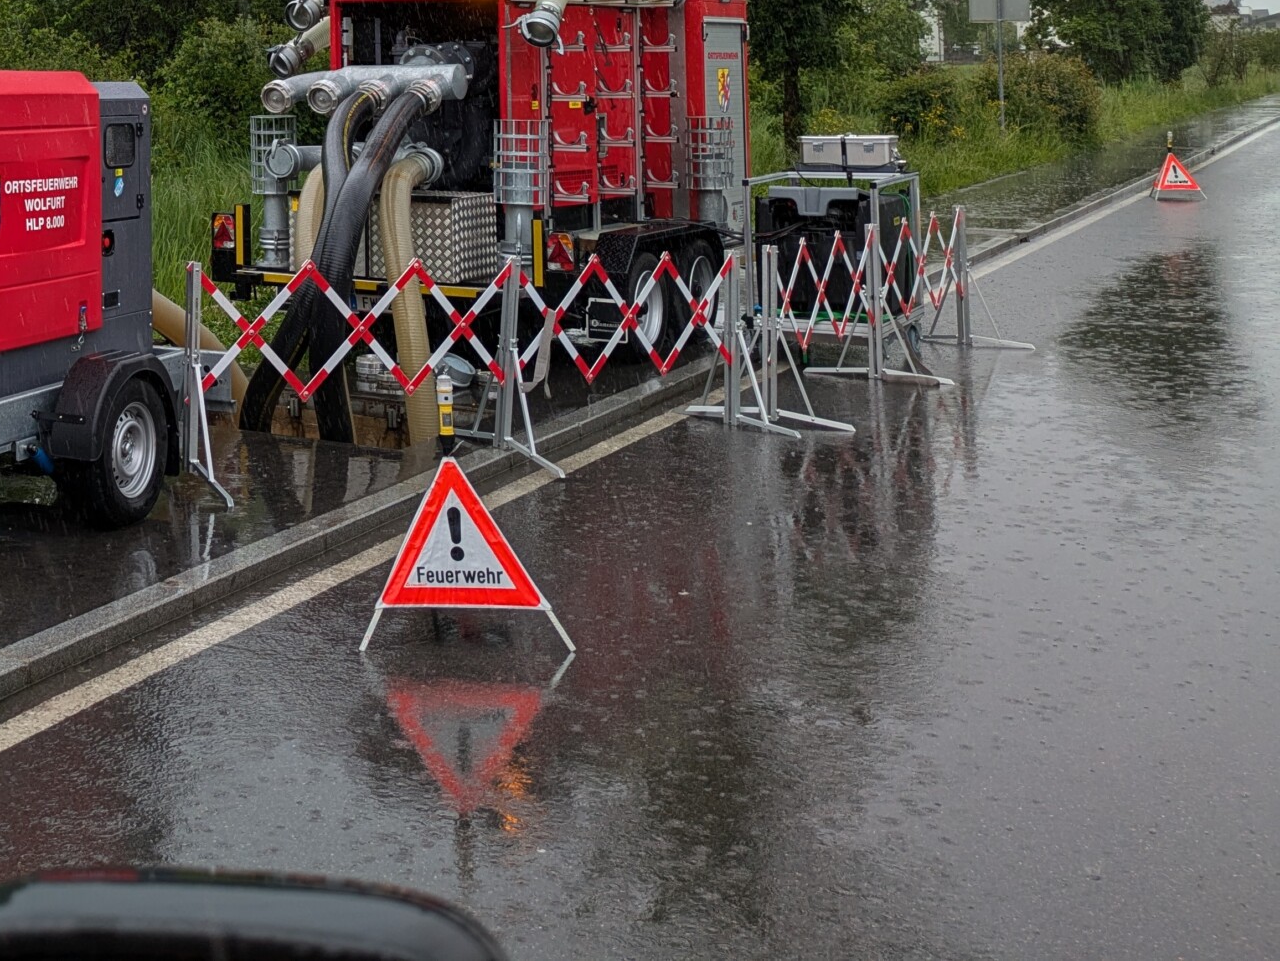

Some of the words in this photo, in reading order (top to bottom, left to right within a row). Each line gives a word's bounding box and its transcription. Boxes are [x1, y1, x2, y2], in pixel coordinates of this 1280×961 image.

[4, 176, 78, 194] ORTSFEUERWEHR
[24, 196, 65, 212] WOLFURT
[26, 217, 45, 231] HLP
[46, 215, 65, 229] 8.000
[416, 566, 503, 584] Feuerwehr
